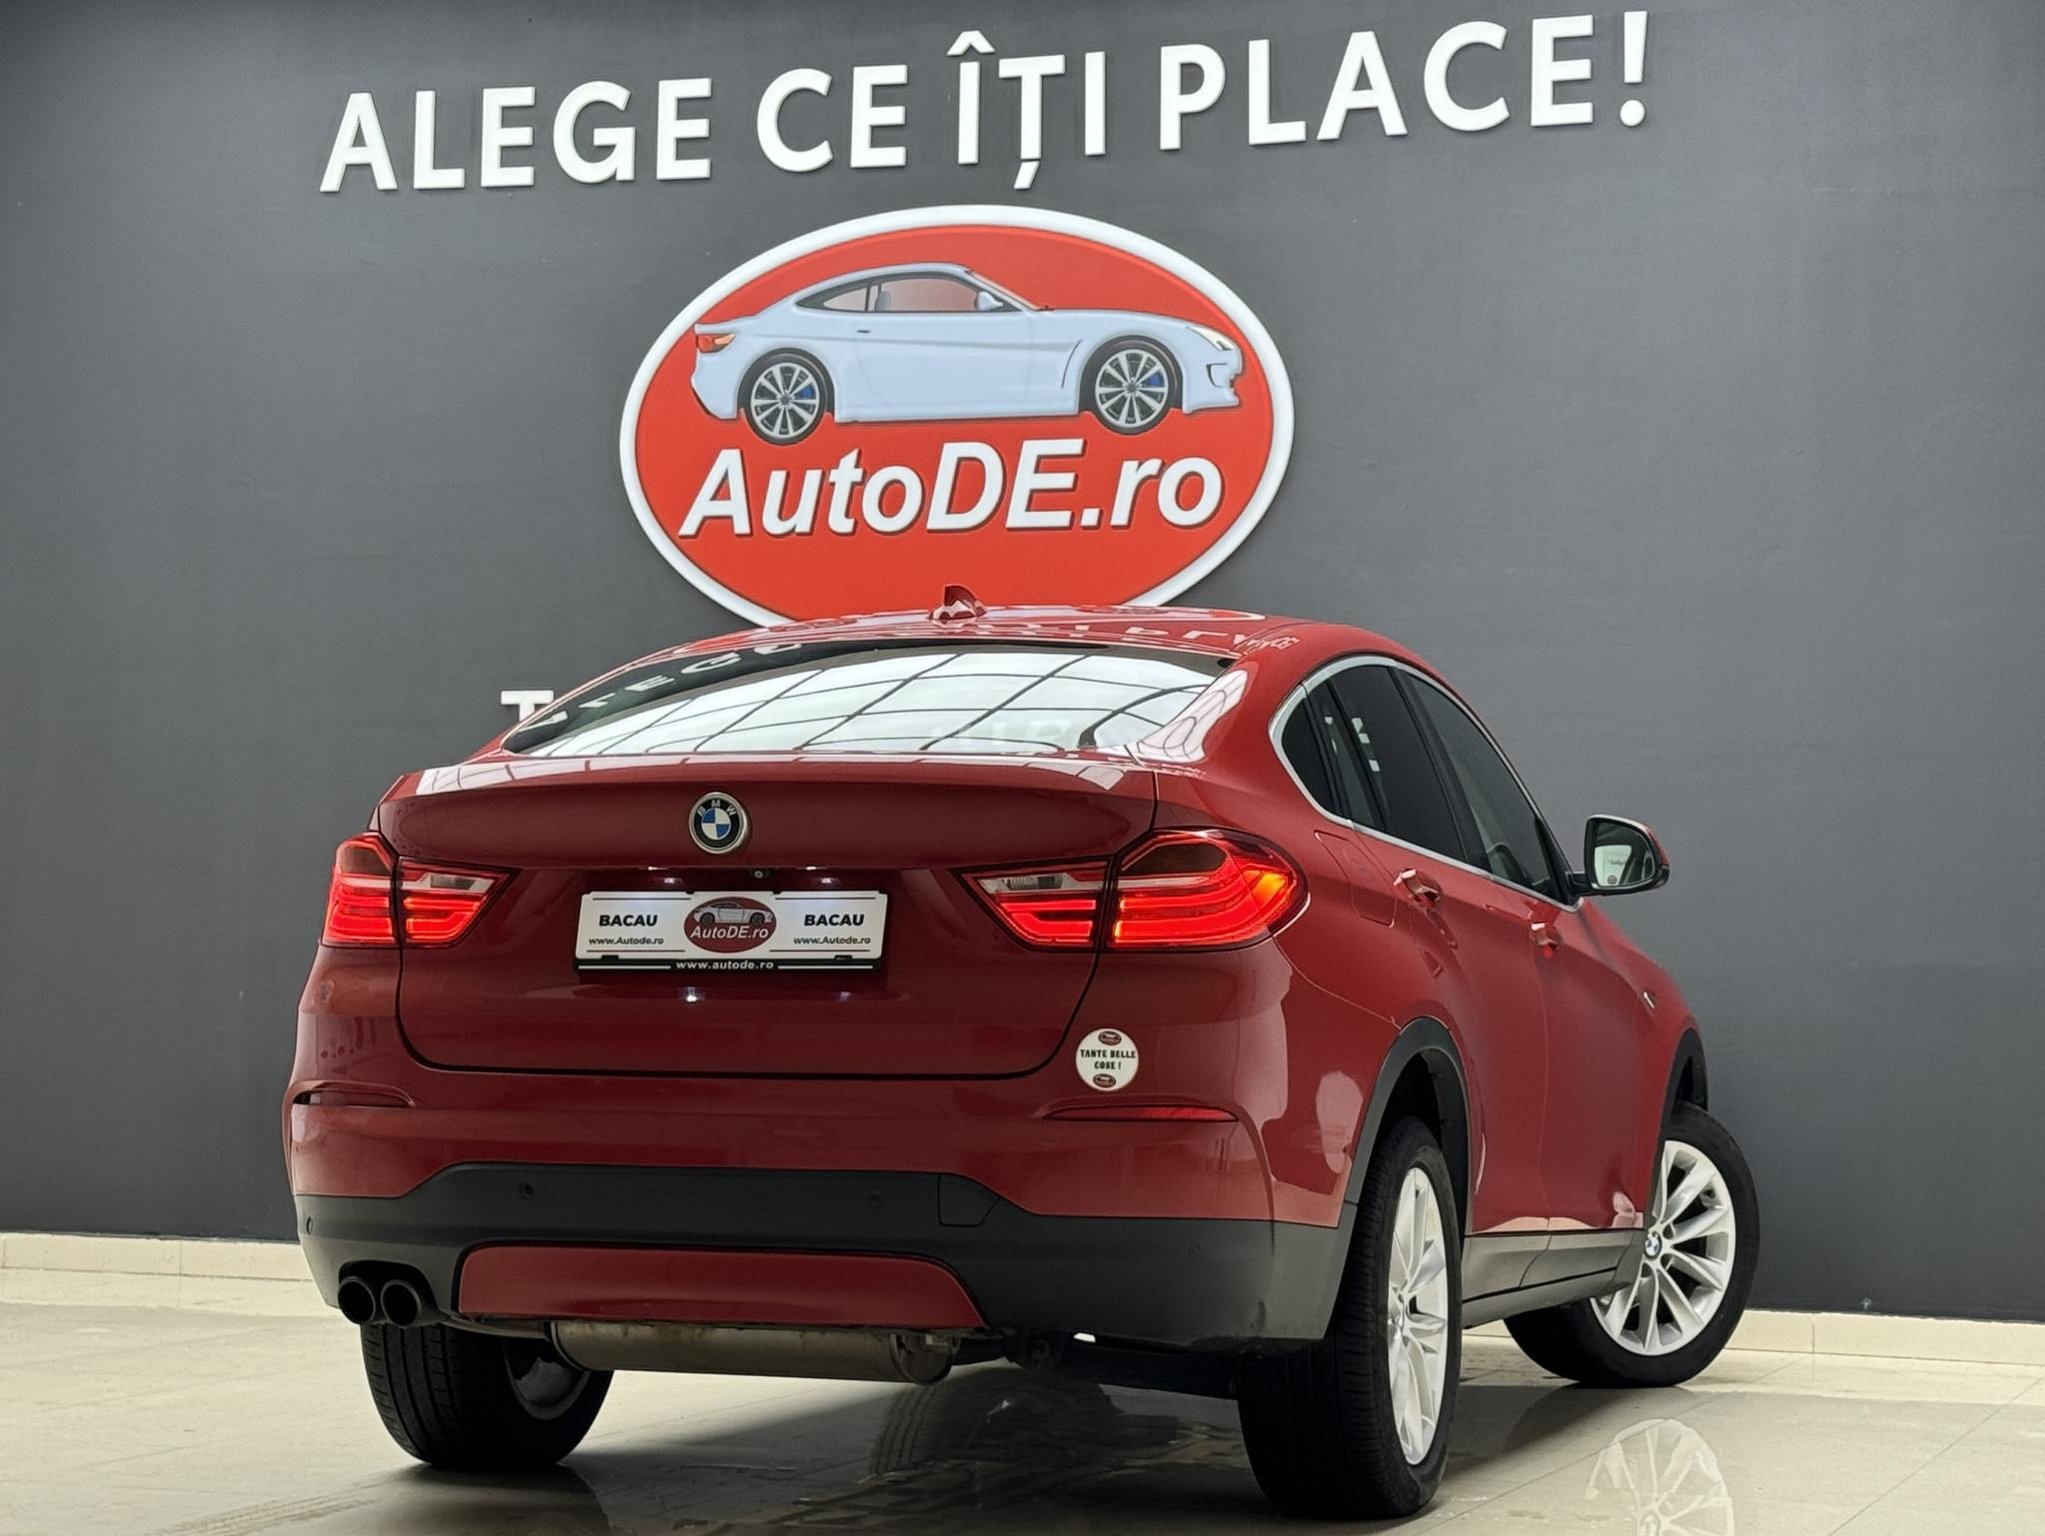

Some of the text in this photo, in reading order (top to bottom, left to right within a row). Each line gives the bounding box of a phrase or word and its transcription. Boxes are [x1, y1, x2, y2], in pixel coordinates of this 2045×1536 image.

[320, 10, 1649, 192] ALEGE CE ÎȚI PLACE!
[677, 437, 1224, 537] AutoDE.ro
[599, 914, 658, 927] BACAU
[804, 913, 865, 926] BACAU
[690, 925, 769, 939] AutoDE.ro
[588, 936, 664, 945] www.Autode.ro
[793, 936, 871, 945] www.Autode.ro
[676, 960, 774, 970] www.autode.ro
[1080, 1049, 1136, 1059] TANTE BELLE
[1094, 1061, 1115, 1070] COSE
